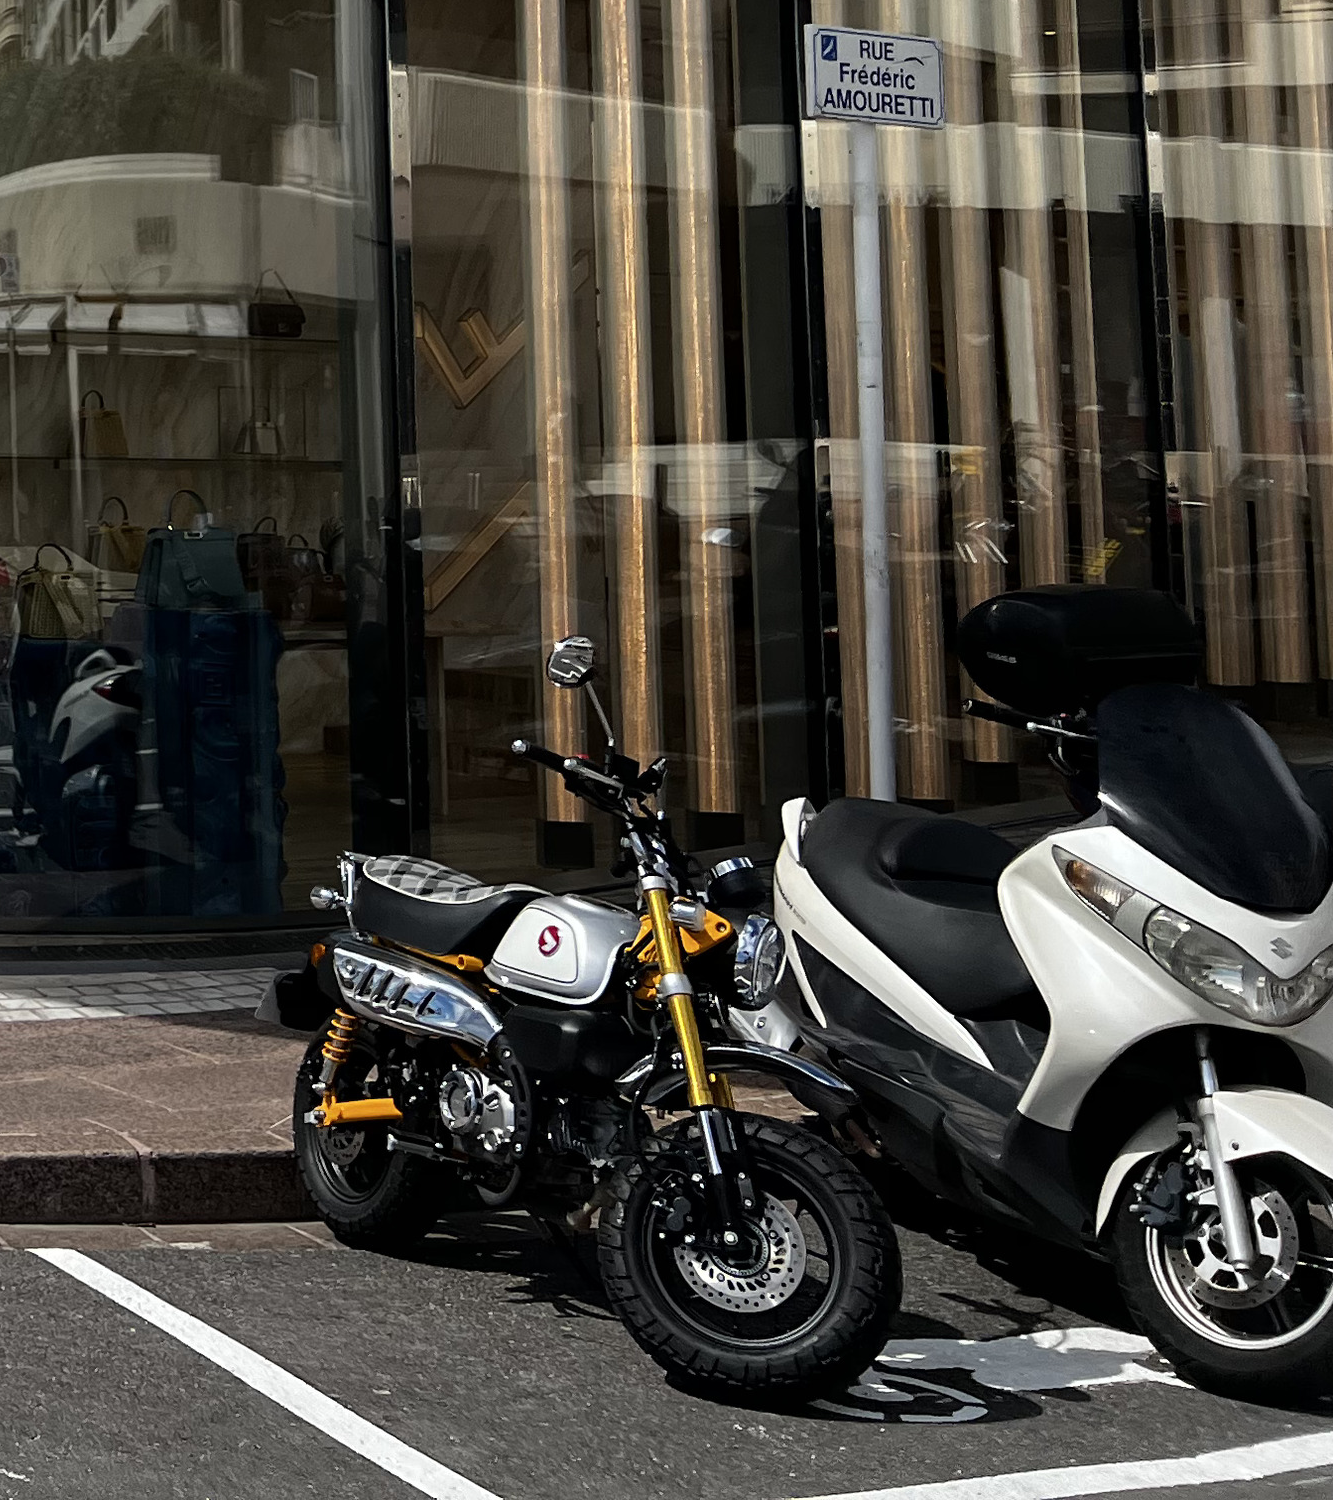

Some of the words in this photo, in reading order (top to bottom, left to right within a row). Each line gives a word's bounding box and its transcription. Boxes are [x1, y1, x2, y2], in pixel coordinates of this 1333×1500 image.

[859, 39, 895, 62] RUE
[839, 62, 916, 91] Frédéric
[823, 87, 935, 119] AMOURETTI
